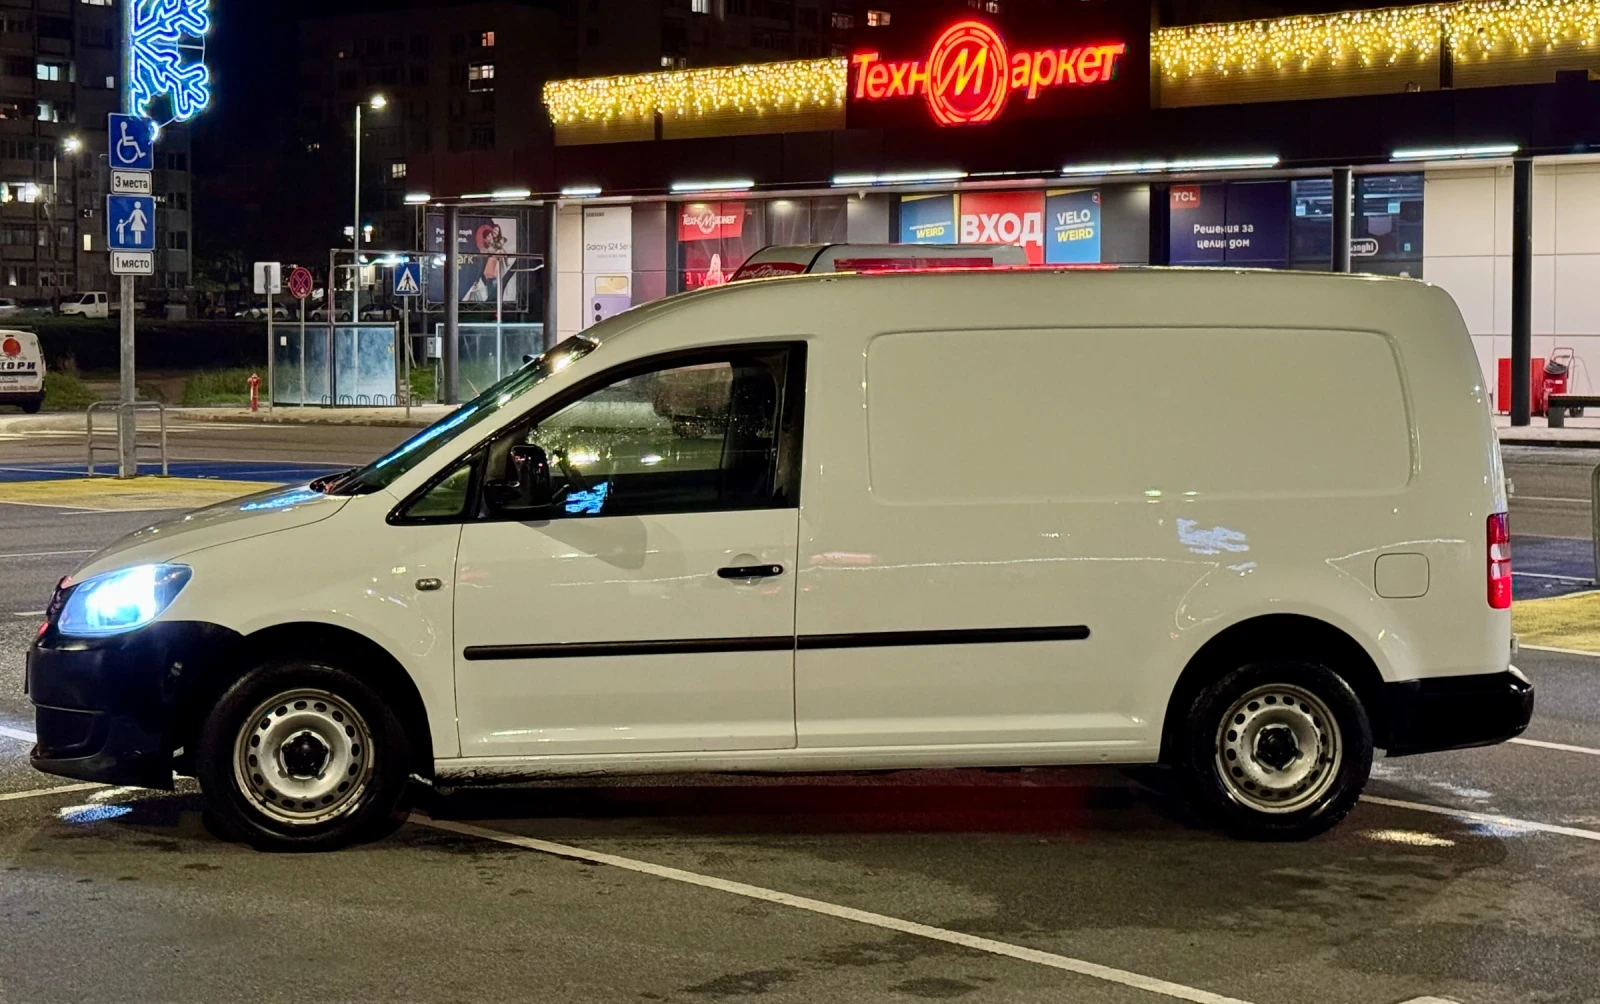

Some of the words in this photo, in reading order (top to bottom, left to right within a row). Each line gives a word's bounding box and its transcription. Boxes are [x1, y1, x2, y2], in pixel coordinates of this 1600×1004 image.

[115, 176, 121, 188] 3
[122, 180, 148, 188] места
[1173, 192, 1196, 201] TCL
[1056, 209, 1091, 225] VELO
[916, 227, 945, 239] WEIRD
[961, 212, 1043, 247] ВХОД
[1057, 227, 1094, 243] WEIRD
[1194, 224, 1239, 235] Решения
[1241, 225, 1254, 234] за
[586, 243, 607, 252] Galaxy
[608, 242, 618, 251] S24
[1197, 239, 1227, 249] целия
[1229, 238, 1250, 249] дом
[116, 257, 120, 268] 1
[121, 259, 150, 268] място
